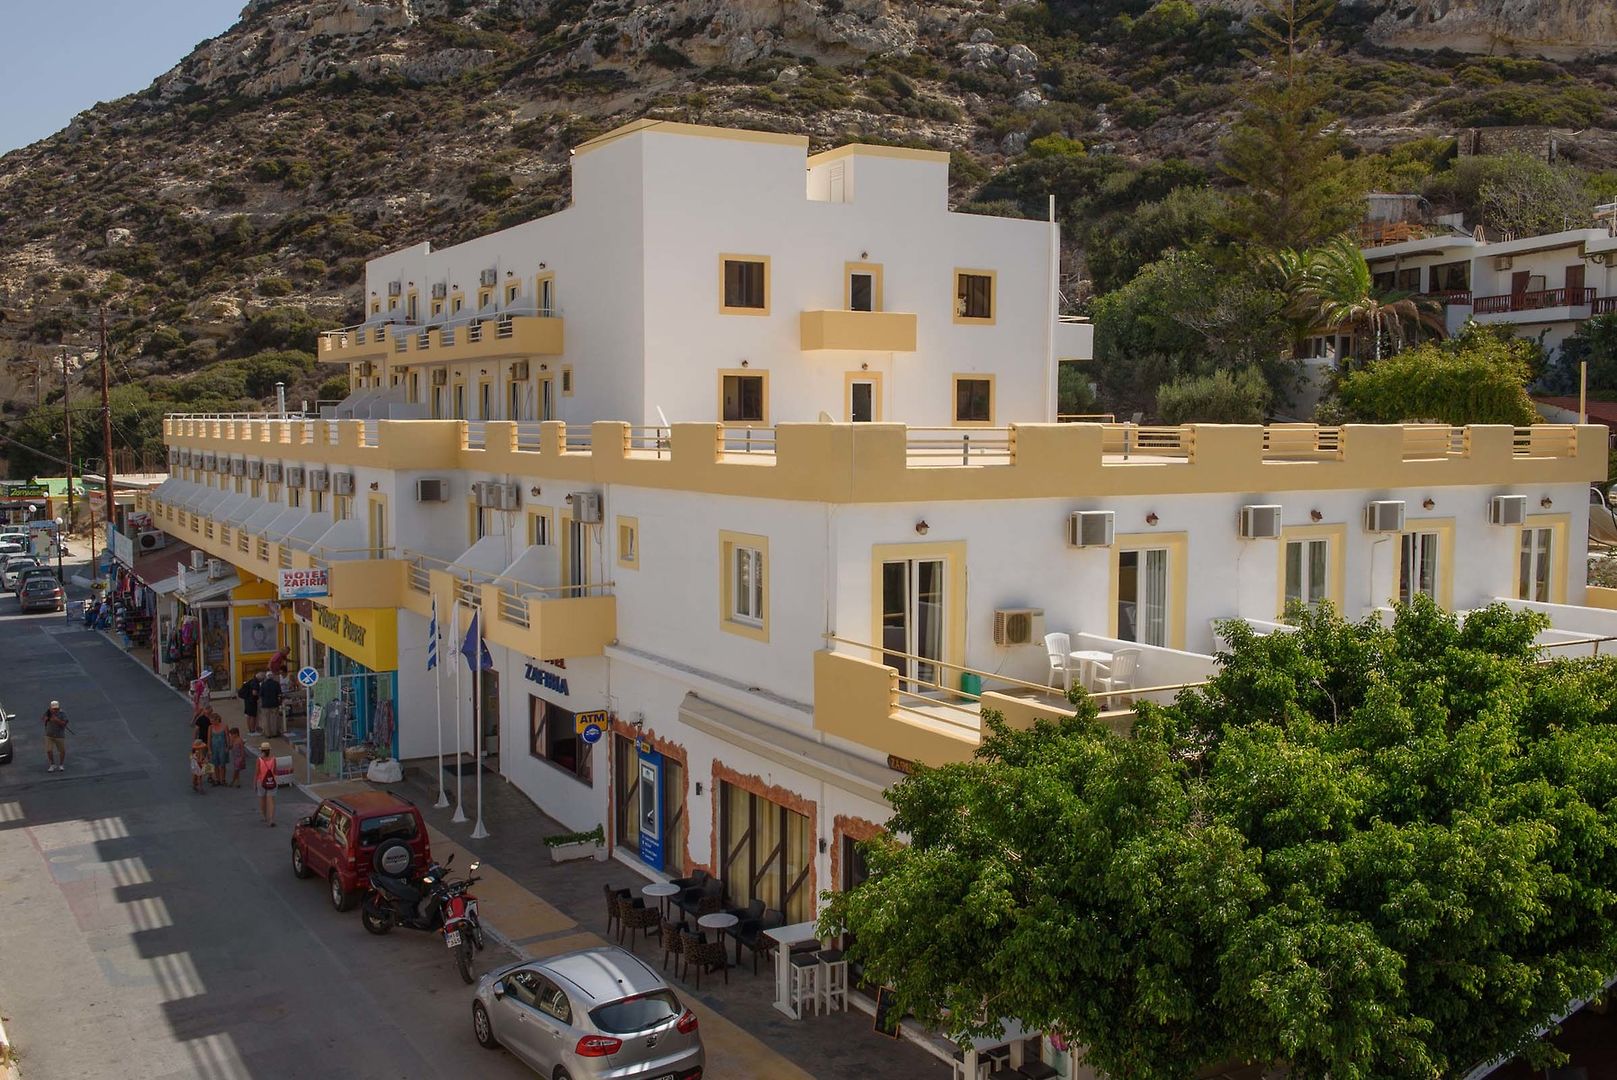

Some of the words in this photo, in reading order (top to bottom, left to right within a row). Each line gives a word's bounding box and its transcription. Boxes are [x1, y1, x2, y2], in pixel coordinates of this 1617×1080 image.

[284, 570, 327, 579] HOTEL
[284, 578, 327, 587] ZAFIRIA
[580, 713, 604, 723] ATM
